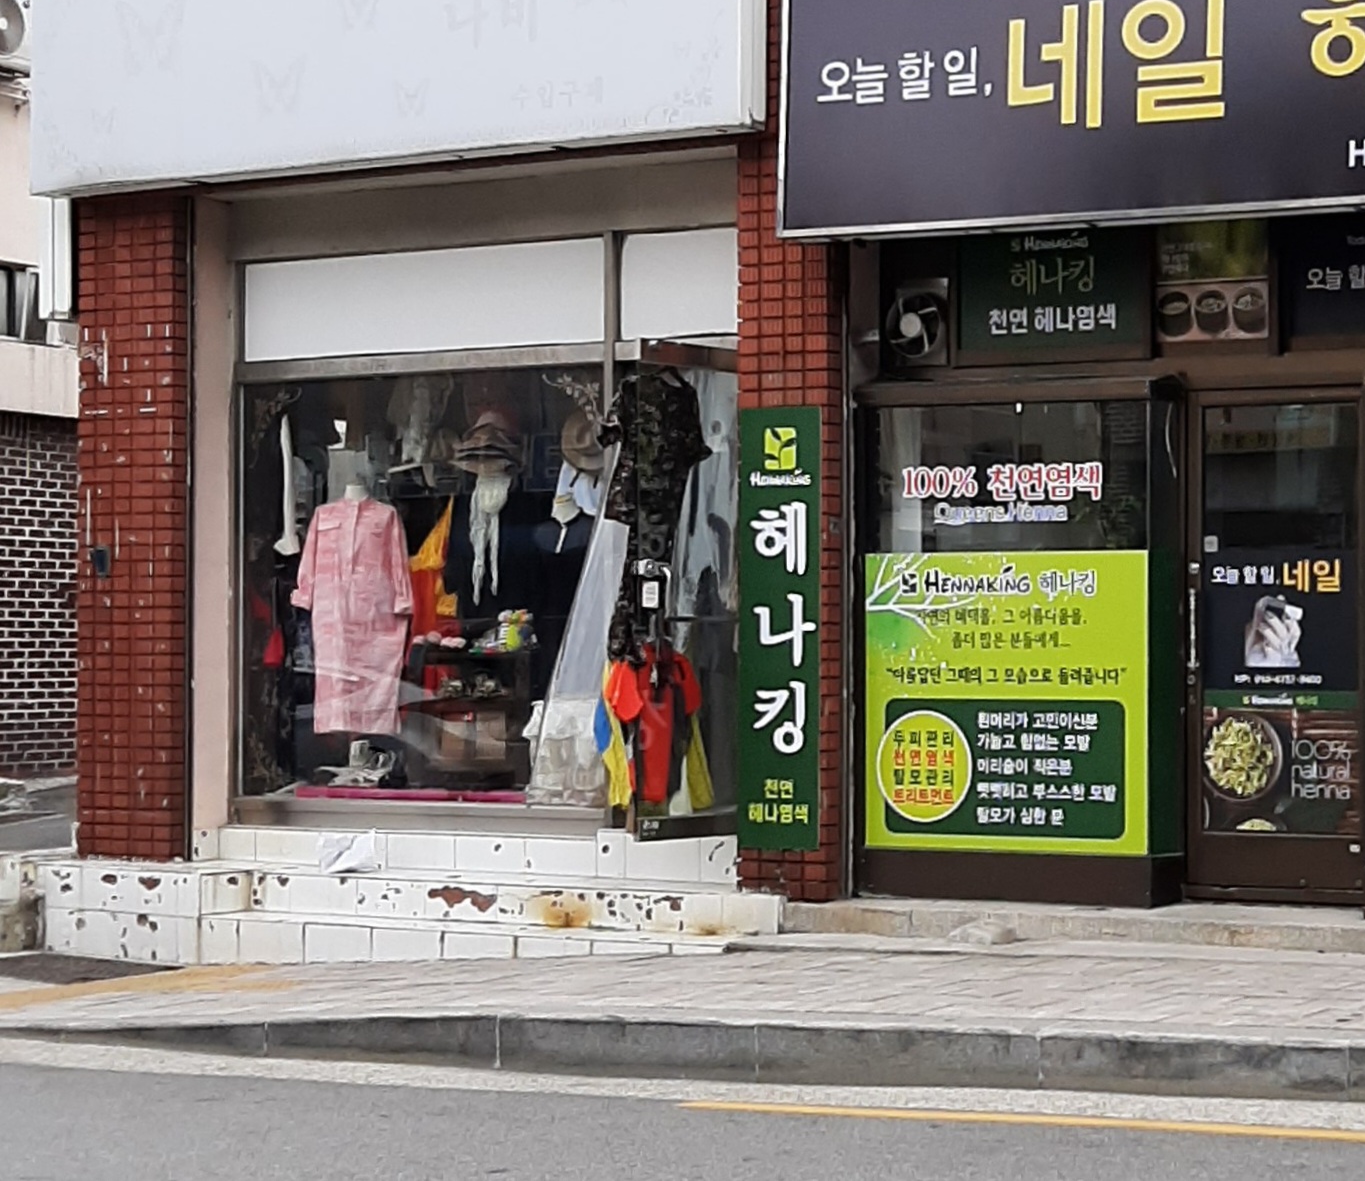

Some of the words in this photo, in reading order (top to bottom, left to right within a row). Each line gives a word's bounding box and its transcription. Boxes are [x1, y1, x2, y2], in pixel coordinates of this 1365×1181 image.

[817, 58, 888, 105] 오늘
[898, 51, 935, 100] 할
[943, 47, 993, 98] 일,
[1009, 255, 1095, 295] 헤나킹
[1306, 267, 1343, 291] 오늘
[1349, 265, 1365, 289] 할
[989, 306, 1029, 335] 천연
[1034, 303, 1117, 333] 헤나염색
[902, 465, 978, 498] 100%
[987, 461, 1103, 501] 천연염색
[924, 563, 1031, 595] HENNAKING
[1038, 568, 1097, 596] 헤나킹
[1211, 566, 1240, 585] 오늘
[1243, 565, 1258, 585] 할
[1283, 558, 1341, 593] 네일
[1003, 608, 1016, 624] 그
[750, 501, 817, 754] 헤나킹
[945, 666, 982, 685] 그때의
[986, 667, 999, 683] 그
[1003, 667, 1053, 685] 모습으로
[1032, 712, 1098, 730] 고민이신분
[977, 733, 1017, 750] 가늘고
[1020, 733, 1059, 751] 힘없는
[1063, 734, 1091, 752] 모발
[1291, 739, 1351, 760] 100%
[1291, 760, 1351, 780] natural
[764, 778, 794, 800] 천연
[892, 787, 955, 805] 트리트먼트
[1032, 783, 1085, 801] 부스스한
[1088, 784, 1117, 803] 모발
[1291, 779, 1351, 800] henna
[748, 803, 809, 825] 헤나염색
[976, 806, 1016, 824] 탈모가
[1020, 807, 1046, 825] 심한
